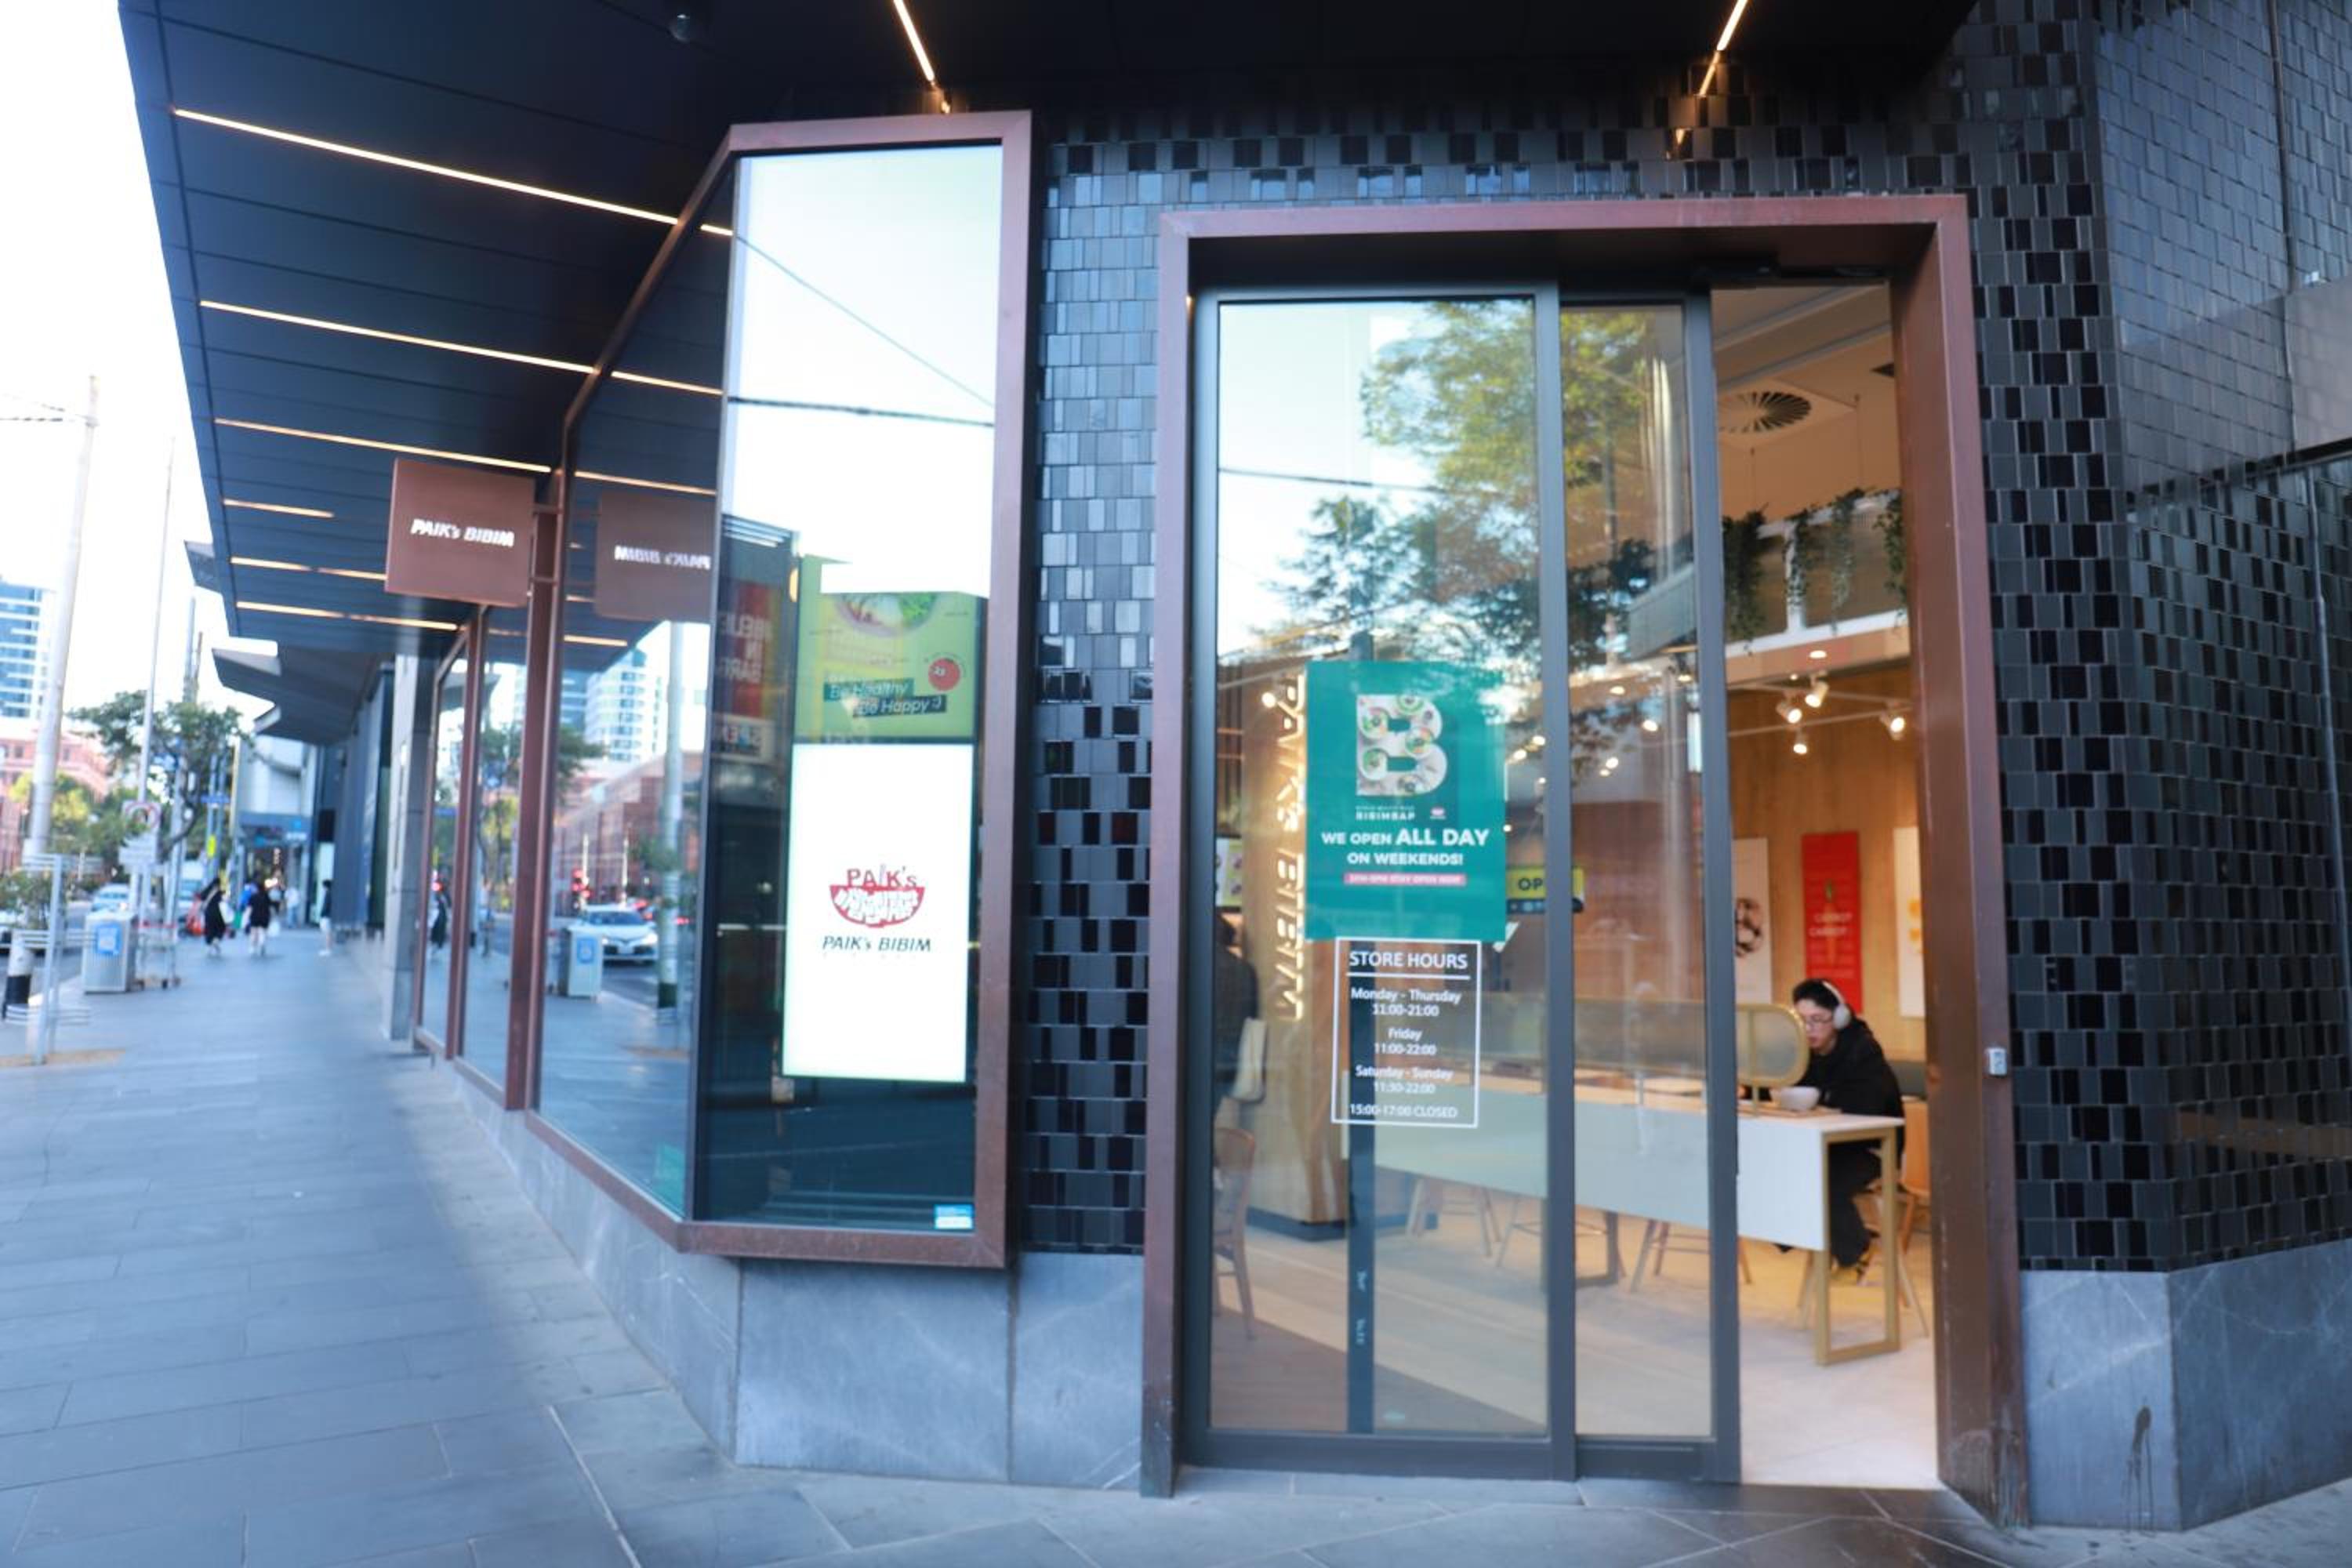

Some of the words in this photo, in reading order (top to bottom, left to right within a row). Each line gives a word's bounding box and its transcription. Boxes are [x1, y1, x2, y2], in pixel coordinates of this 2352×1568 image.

[410, 518, 460, 539] PAIK's
[464, 525, 514, 547] BIBIM
[880, 698, 929, 715] Happy
[1320, 831, 1346, 845] WE
[1349, 832, 1392, 846] OPEN
[1396, 828, 1436, 846] ALL
[1443, 829, 1490, 847] DAY
[1346, 852, 1370, 865] ON
[1374, 852, 1464, 866] WEEKENDS!
[822, 935, 872, 951] PAIK's
[877, 937, 931, 953] BIBIM
[1349, 951, 1404, 967] STORE
[1407, 953, 1468, 969] HOURS
[1351, 987, 1398, 1002] Monday
[1410, 989, 1462, 1004] Thursday
[1388, 1027, 1423, 1041] Friday
[1355, 1064, 1404, 1080] Saturday
[1411, 1066, 1454, 1082] Sunday
[1414, 1105, 1458, 1118] CLOSED
